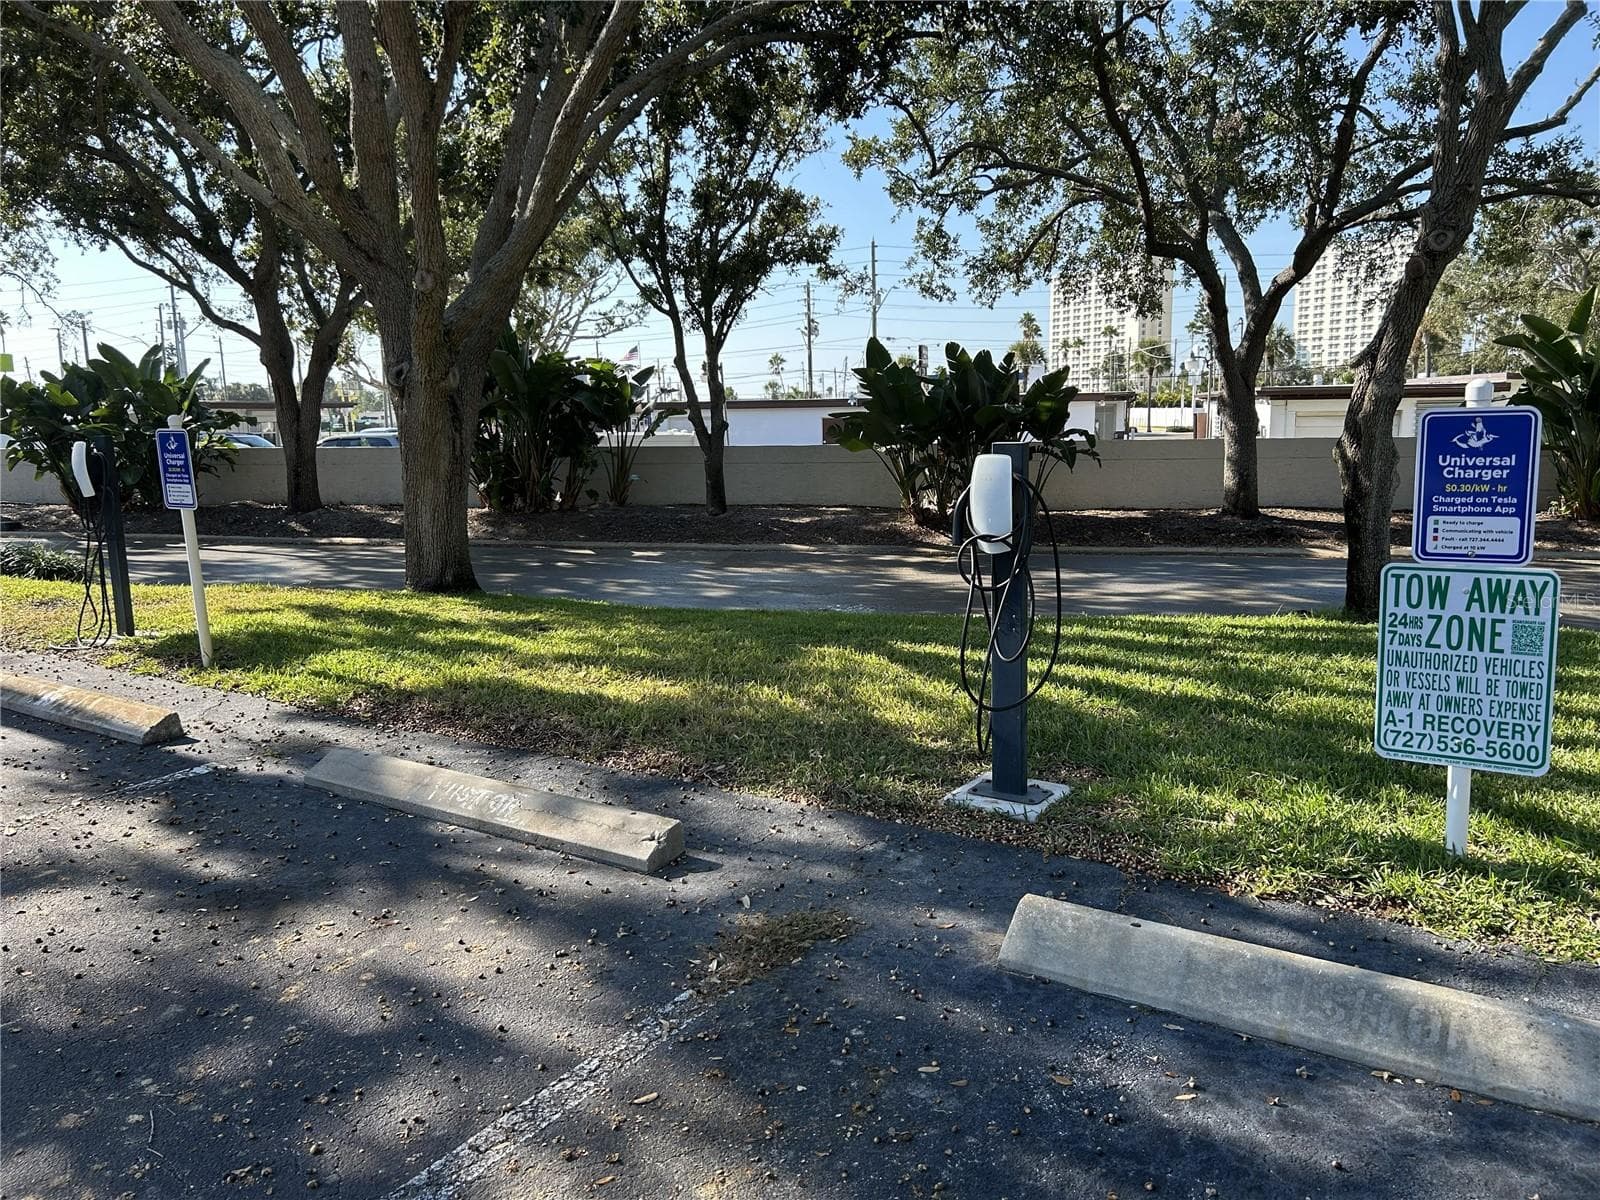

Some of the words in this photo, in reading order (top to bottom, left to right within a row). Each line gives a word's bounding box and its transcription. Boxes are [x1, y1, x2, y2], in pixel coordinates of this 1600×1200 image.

[1438, 454, 1516, 467] Universal
[1443, 467, 1510, 480] Charger
[1432, 495, 1474, 505] Charged
[1491, 496, 1518, 504] Tesla
[1445, 483, 1490, 493] $0.30/kW
[1497, 484, 1508, 493] hr
[1432, 505, 1492, 515] Smartphone
[1494, 505, 1516, 515] App
[1391, 573, 1450, 610] TOW
[1465, 576, 1550, 616] AWAY
[1425, 614, 1506, 654] ZONE
[1386, 649, 1478, 673] UNAUTHORIZED
[1484, 657, 1545, 680] VEHICLES
[1386, 669, 1400, 688] OR
[1405, 671, 1450, 693] VESSELS
[1456, 675, 1481, 695] WILL
[1486, 678, 1500, 697] BE
[1505, 679, 1543, 701] TOWED
[1385, 690, 1414, 709] AWAY
[1418, 693, 1431, 711] AT
[1436, 694, 1483, 716] OWNERS
[1489, 700, 1542, 722] EXPENSE
[1384, 709, 1413, 729] A-1
[1422, 713, 1541, 743] RECOVERY
